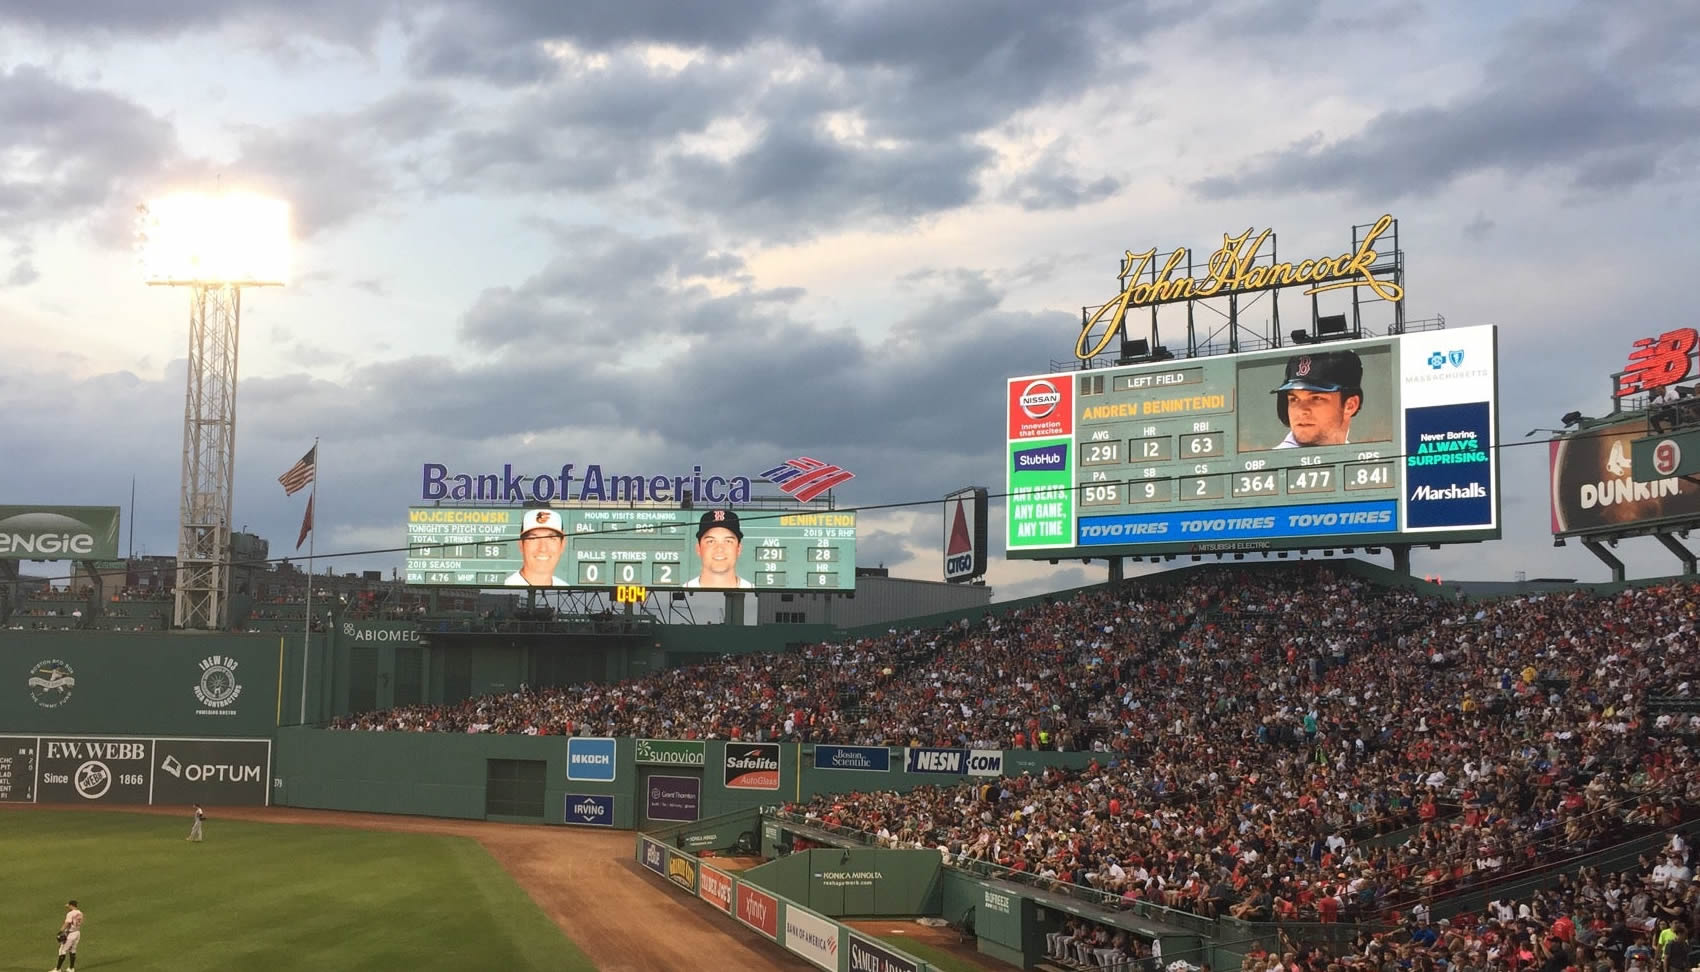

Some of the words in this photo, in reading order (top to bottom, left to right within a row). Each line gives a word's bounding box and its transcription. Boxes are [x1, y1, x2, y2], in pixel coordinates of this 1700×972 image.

[1075, 247, 1195, 360] John
[1191, 214, 1404, 301] Hancock
[1128, 376, 1152, 388] LEFT
[1156, 373, 1184, 386] FIELD
[1405, 370, 1488, 384] MASSACHUSETTS
[1023, 395, 1057, 404] NISSAN
[1083, 403, 1138, 421] ANDREW
[1143, 395, 1225, 415] BENINTENDI
[1144, 427, 1156, 437] HR
[1193, 422, 1209, 432] RBI
[1092, 431, 1109, 440] AVG
[1421, 433, 1444, 441] Never
[1447, 431, 1477, 440] Boring.
[1143, 442, 1159, 457] 12
[1191, 438, 1213, 453] 63
[1418, 440, 1478, 454] ALWAYS
[1020, 453, 1060, 465] StubHub
[1086, 445, 1117, 462] .291
[1358, 452, 1380, 462] OPS
[1408, 452, 1488, 467] SURPRISING.
[1657, 444, 1675, 472] 9
[1245, 460, 1265, 471] OBP
[1300, 456, 1321, 466] SLG
[1143, 469, 1156, 478] SB
[1195, 465, 1208, 474] CS
[1093, 472, 1106, 481] PA
[1290, 471, 1330, 489] .477
[1350, 467, 1388, 486] .841
[422, 463, 525, 501] Bank
[532, 463, 574, 502] of
[579, 464, 751, 503] America
[1196, 480, 1206, 495] 2
[1234, 475, 1275, 493] .364
[1013, 486, 1032, 502] ANY
[1034, 484, 1068, 501] SEATS,
[1086, 486, 1117, 501] 505
[1145, 483, 1155, 497] 9
[1411, 482, 1486, 501] Marshalls
[410, 511, 509, 523] WOJCIECHOWSKI
[637, 512, 676, 520] REMAINING
[1014, 503, 1033, 520] ANY
[1036, 502, 1066, 519] GAME,
[781, 514, 854, 526] BENINTENDI
[1181, 519, 1226, 533] TOYO
[1227, 516, 1275, 530] TIRES
[1289, 512, 1338, 527] TOYO
[1341, 510, 1392, 524] TIRES
[409, 525, 449, 534] TONIGHT'S
[452, 525, 476, 533] PITCH
[479, 525, 506, 533] COUNT
[576, 523, 594, 532] BAL
[635, 523, 654, 532] BOS
[670, 525, 676, 533] 5
[1017, 521, 1037, 537] ANY
[1039, 520, 1064, 537] TIME
[1081, 525, 1123, 537] TOYO
[1125, 522, 1168, 535] TIRES
[762, 539, 780, 547] AVG
[817, 539, 829, 547] 2B
[1199, 543, 1235, 551] MITSUBISHI
[1237, 541, 1270, 550] ELECTRIC
[419, 546, 431, 556] 19
[455, 546, 462, 556] 11
[485, 546, 499, 556] 58
[577, 551, 606, 559] BALLS
[611, 552, 647, 560] STRIKES
[655, 552, 679, 560] OUTS
[759, 549, 782, 560] .291
[816, 550, 830, 560] 28
[765, 563, 776, 571] 3B
[947, 554, 972, 574] CITGO
[431, 573, 449, 582] 4.76
[484, 574, 498, 582] 1.21
[587, 565, 598, 581] 0
[623, 565, 634, 581] 0
[660, 566, 672, 583] 2
[767, 574, 774, 584] 5
[819, 574, 826, 585] 8
[617, 585, 646, 602] 0:04
[355, 630, 420, 641] ABIOMED
[198, 655, 221, 671] IBEW
[224, 656, 238, 671] 103
[47, 742, 82, 759] F.W.
[86, 742, 145, 760] WEBB
[650, 749, 704, 764] sunovion
[837, 749, 862, 759] Boston
[581, 754, 609, 764] KOCH
[727, 757, 778, 771] Safelite
[832, 755, 871, 767] Scientific
[917, 752, 960, 771] NESN
[44, 773, 68, 784] Since
[120, 774, 143, 785] 1866
[185, 764, 260, 782] OPTUM
[740, 776, 777, 787] AutoGlass
[574, 804, 604, 816] IRVING
[746, 892, 767, 928] xfinity
[787, 922, 798, 937] BANK
[799, 928, 805, 940] OF
[806, 930, 827, 951] AMERICA
[851, 943, 880, 972] SAMUEL
